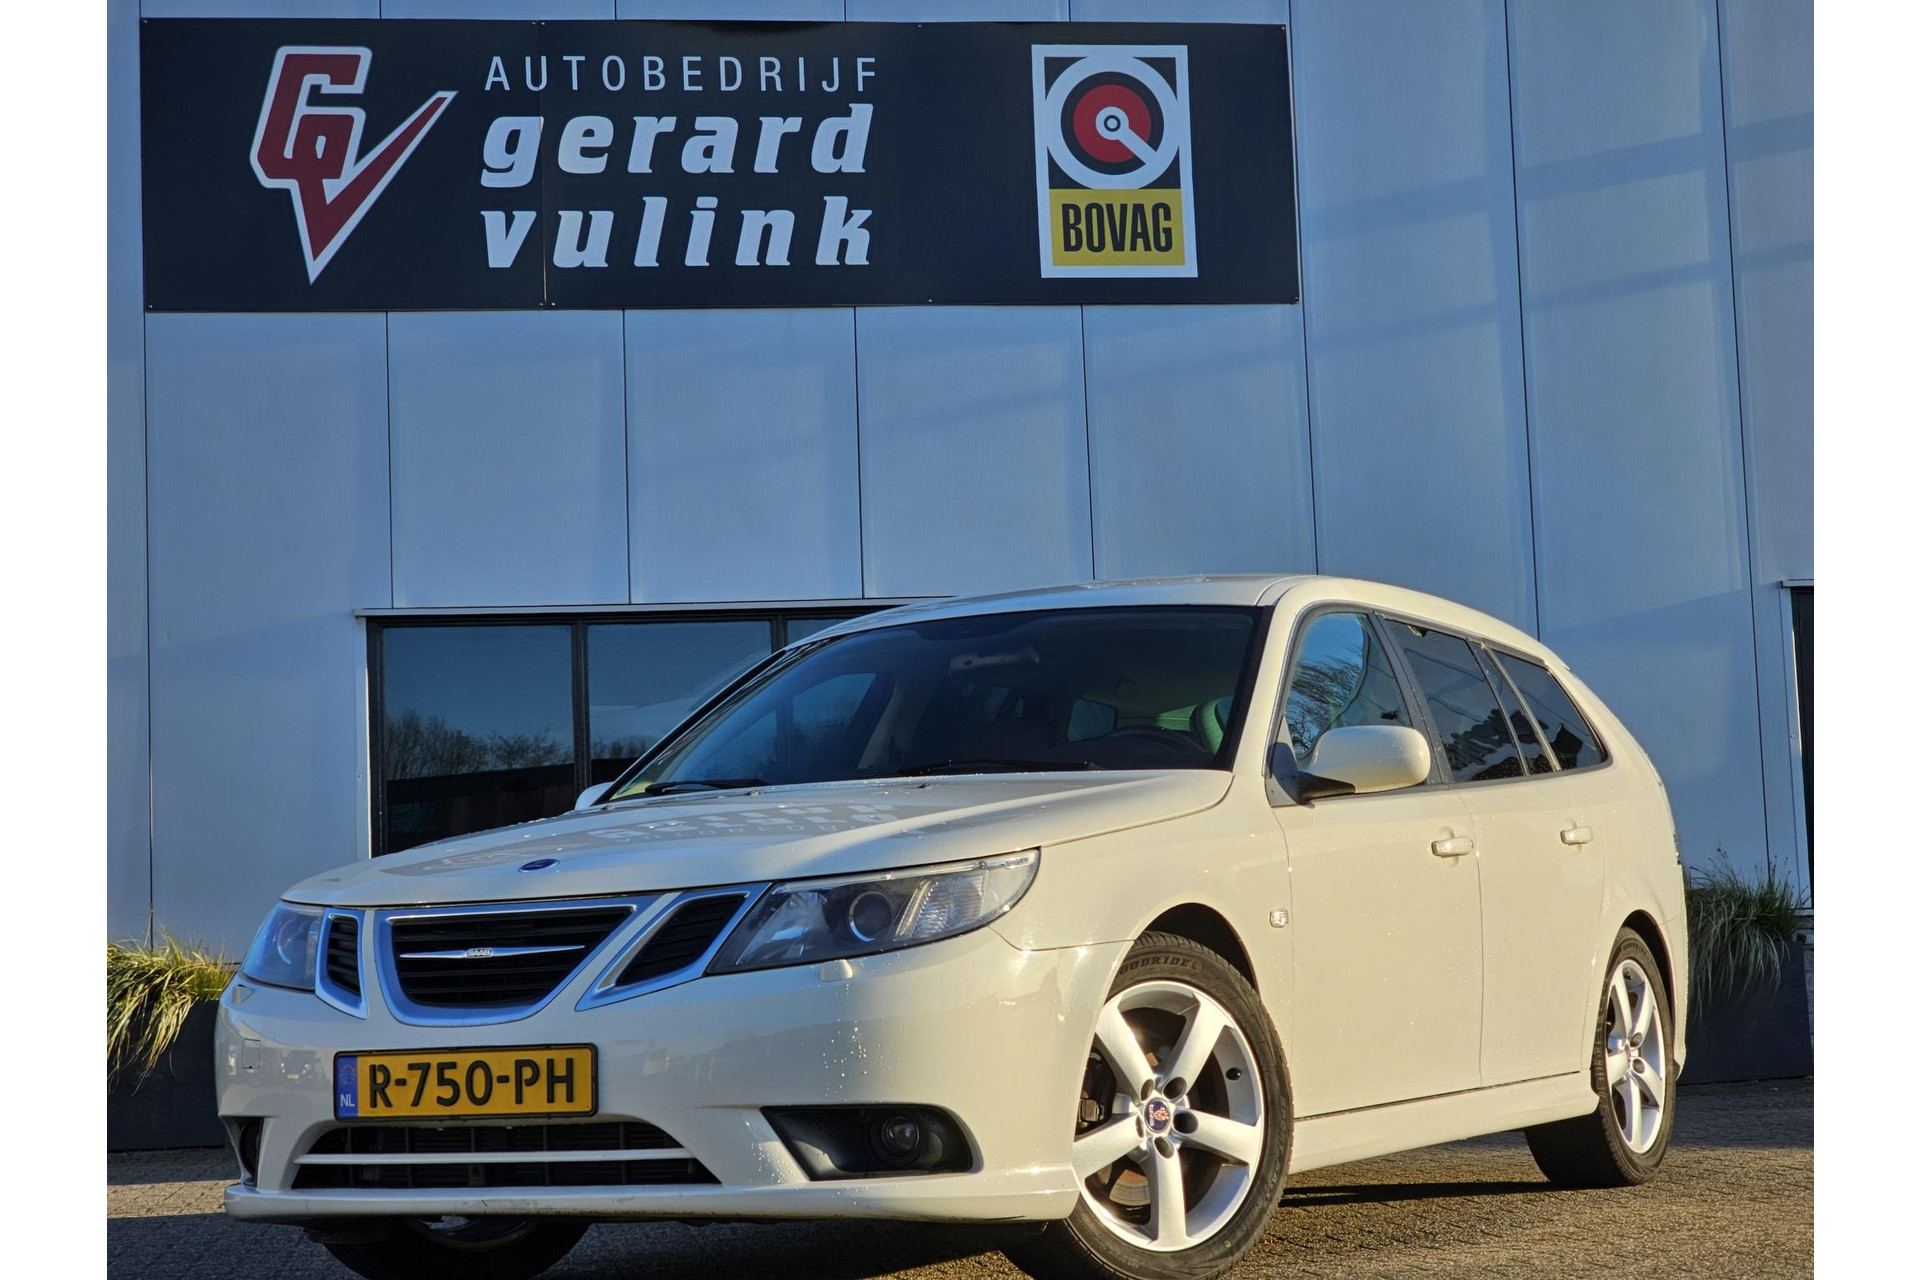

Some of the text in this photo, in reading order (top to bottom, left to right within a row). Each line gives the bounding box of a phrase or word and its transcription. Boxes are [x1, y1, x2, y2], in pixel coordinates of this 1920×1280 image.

[485, 56, 876, 92] AUTOBEDRIJF
[481, 103, 873, 187] gerard
[481, 196, 872, 268] vulink
[1061, 203, 1173, 252] BOVAG
[1119, 956, 1190, 975] OODRIDE
[340, 1093, 355, 1107] NL
[369, 1058, 574, 1109] R-750-PH
